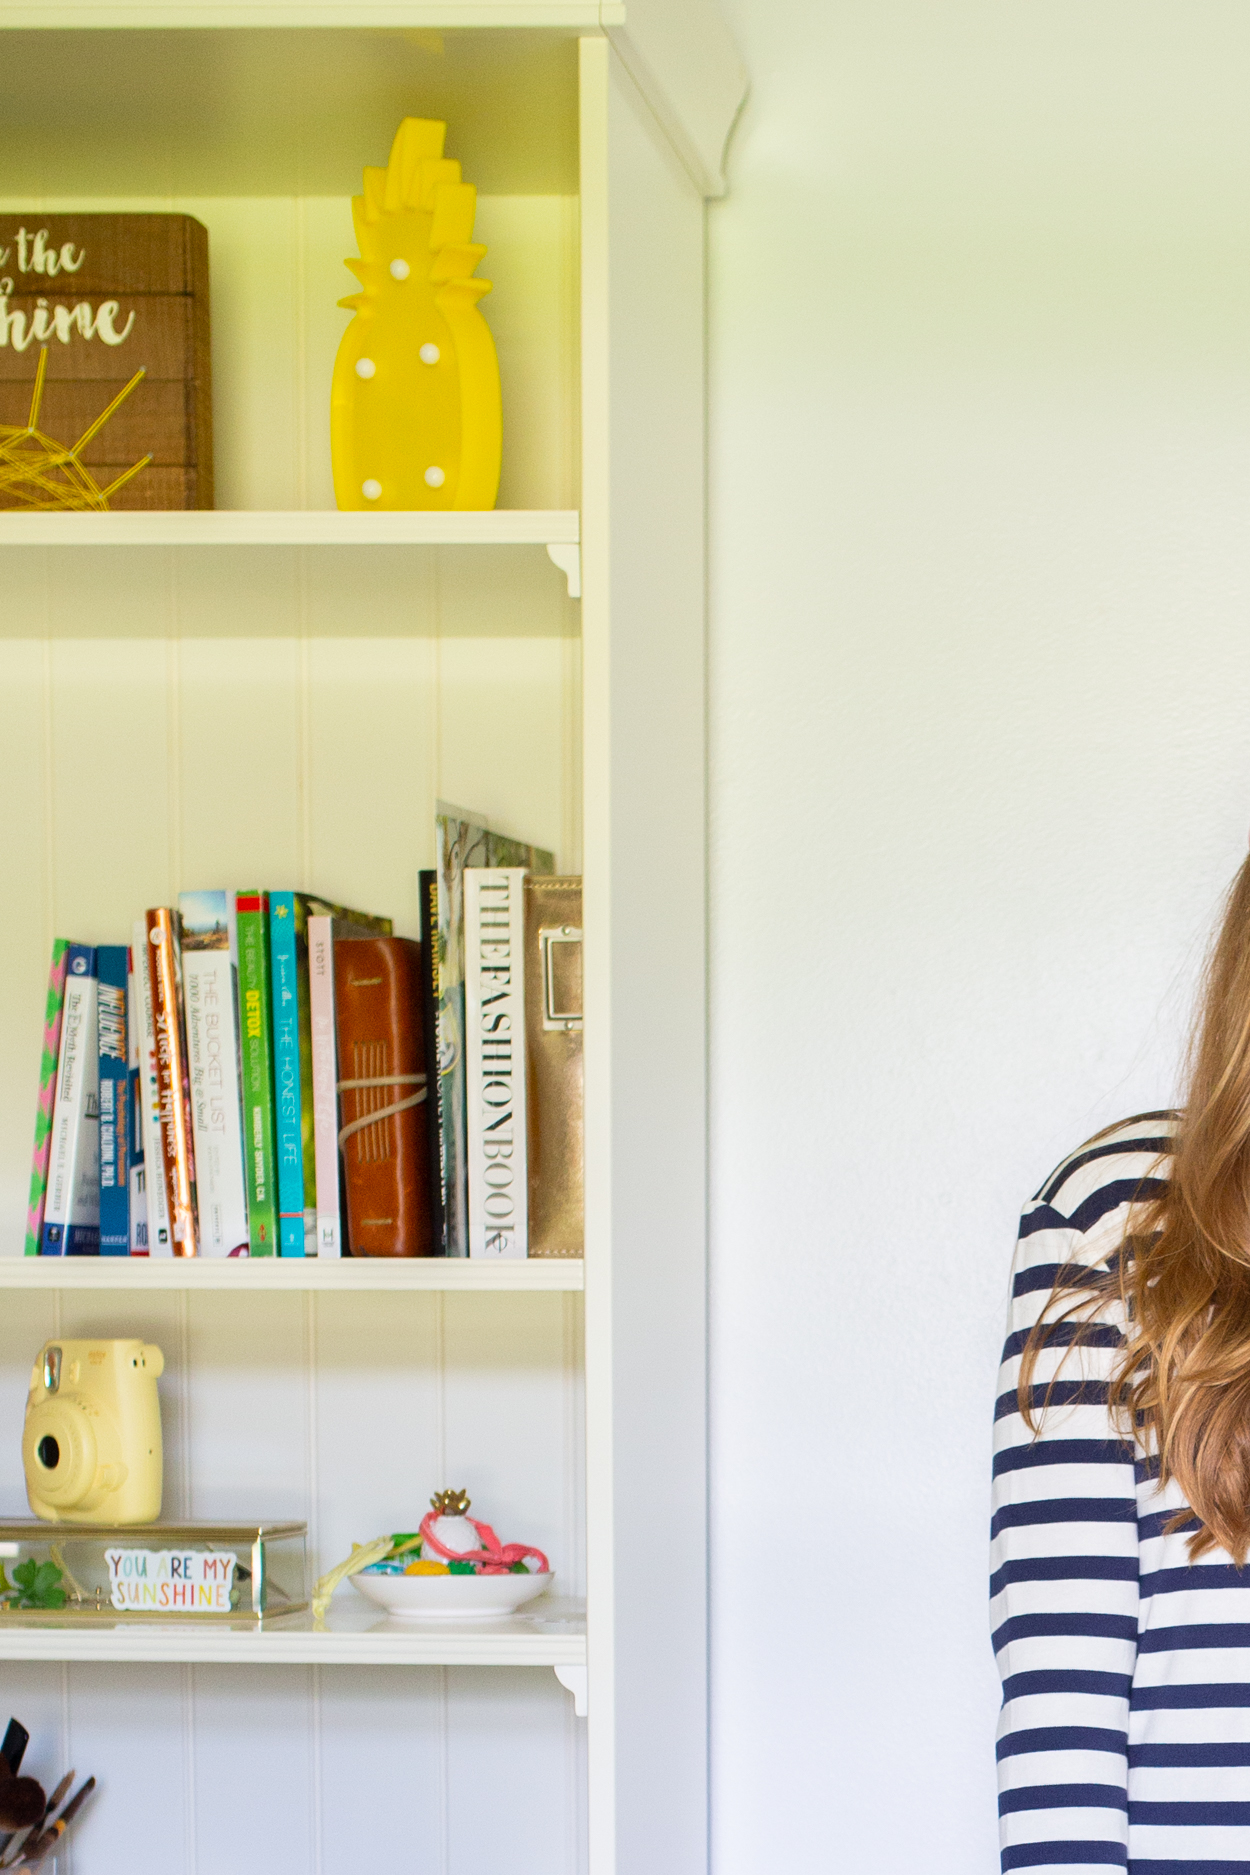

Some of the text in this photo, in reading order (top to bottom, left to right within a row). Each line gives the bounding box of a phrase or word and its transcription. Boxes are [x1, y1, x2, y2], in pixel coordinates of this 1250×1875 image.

[14, 226, 86, 277] the
[316, 942, 326, 976] STOTT
[203, 970, 218, 1006] THE
[99, 983, 127, 1063] INFLUENCE
[246, 990, 261, 1038] DETOX
[205, 1013, 223, 1089] BUCKET
[280, 1017, 298, 1166] THE HONEST LIFE
[210, 1096, 225, 1135] LIST
[110, 1555, 231, 1581] YOU ARE MY
[117, 1582, 226, 1607] SUNSHINE
